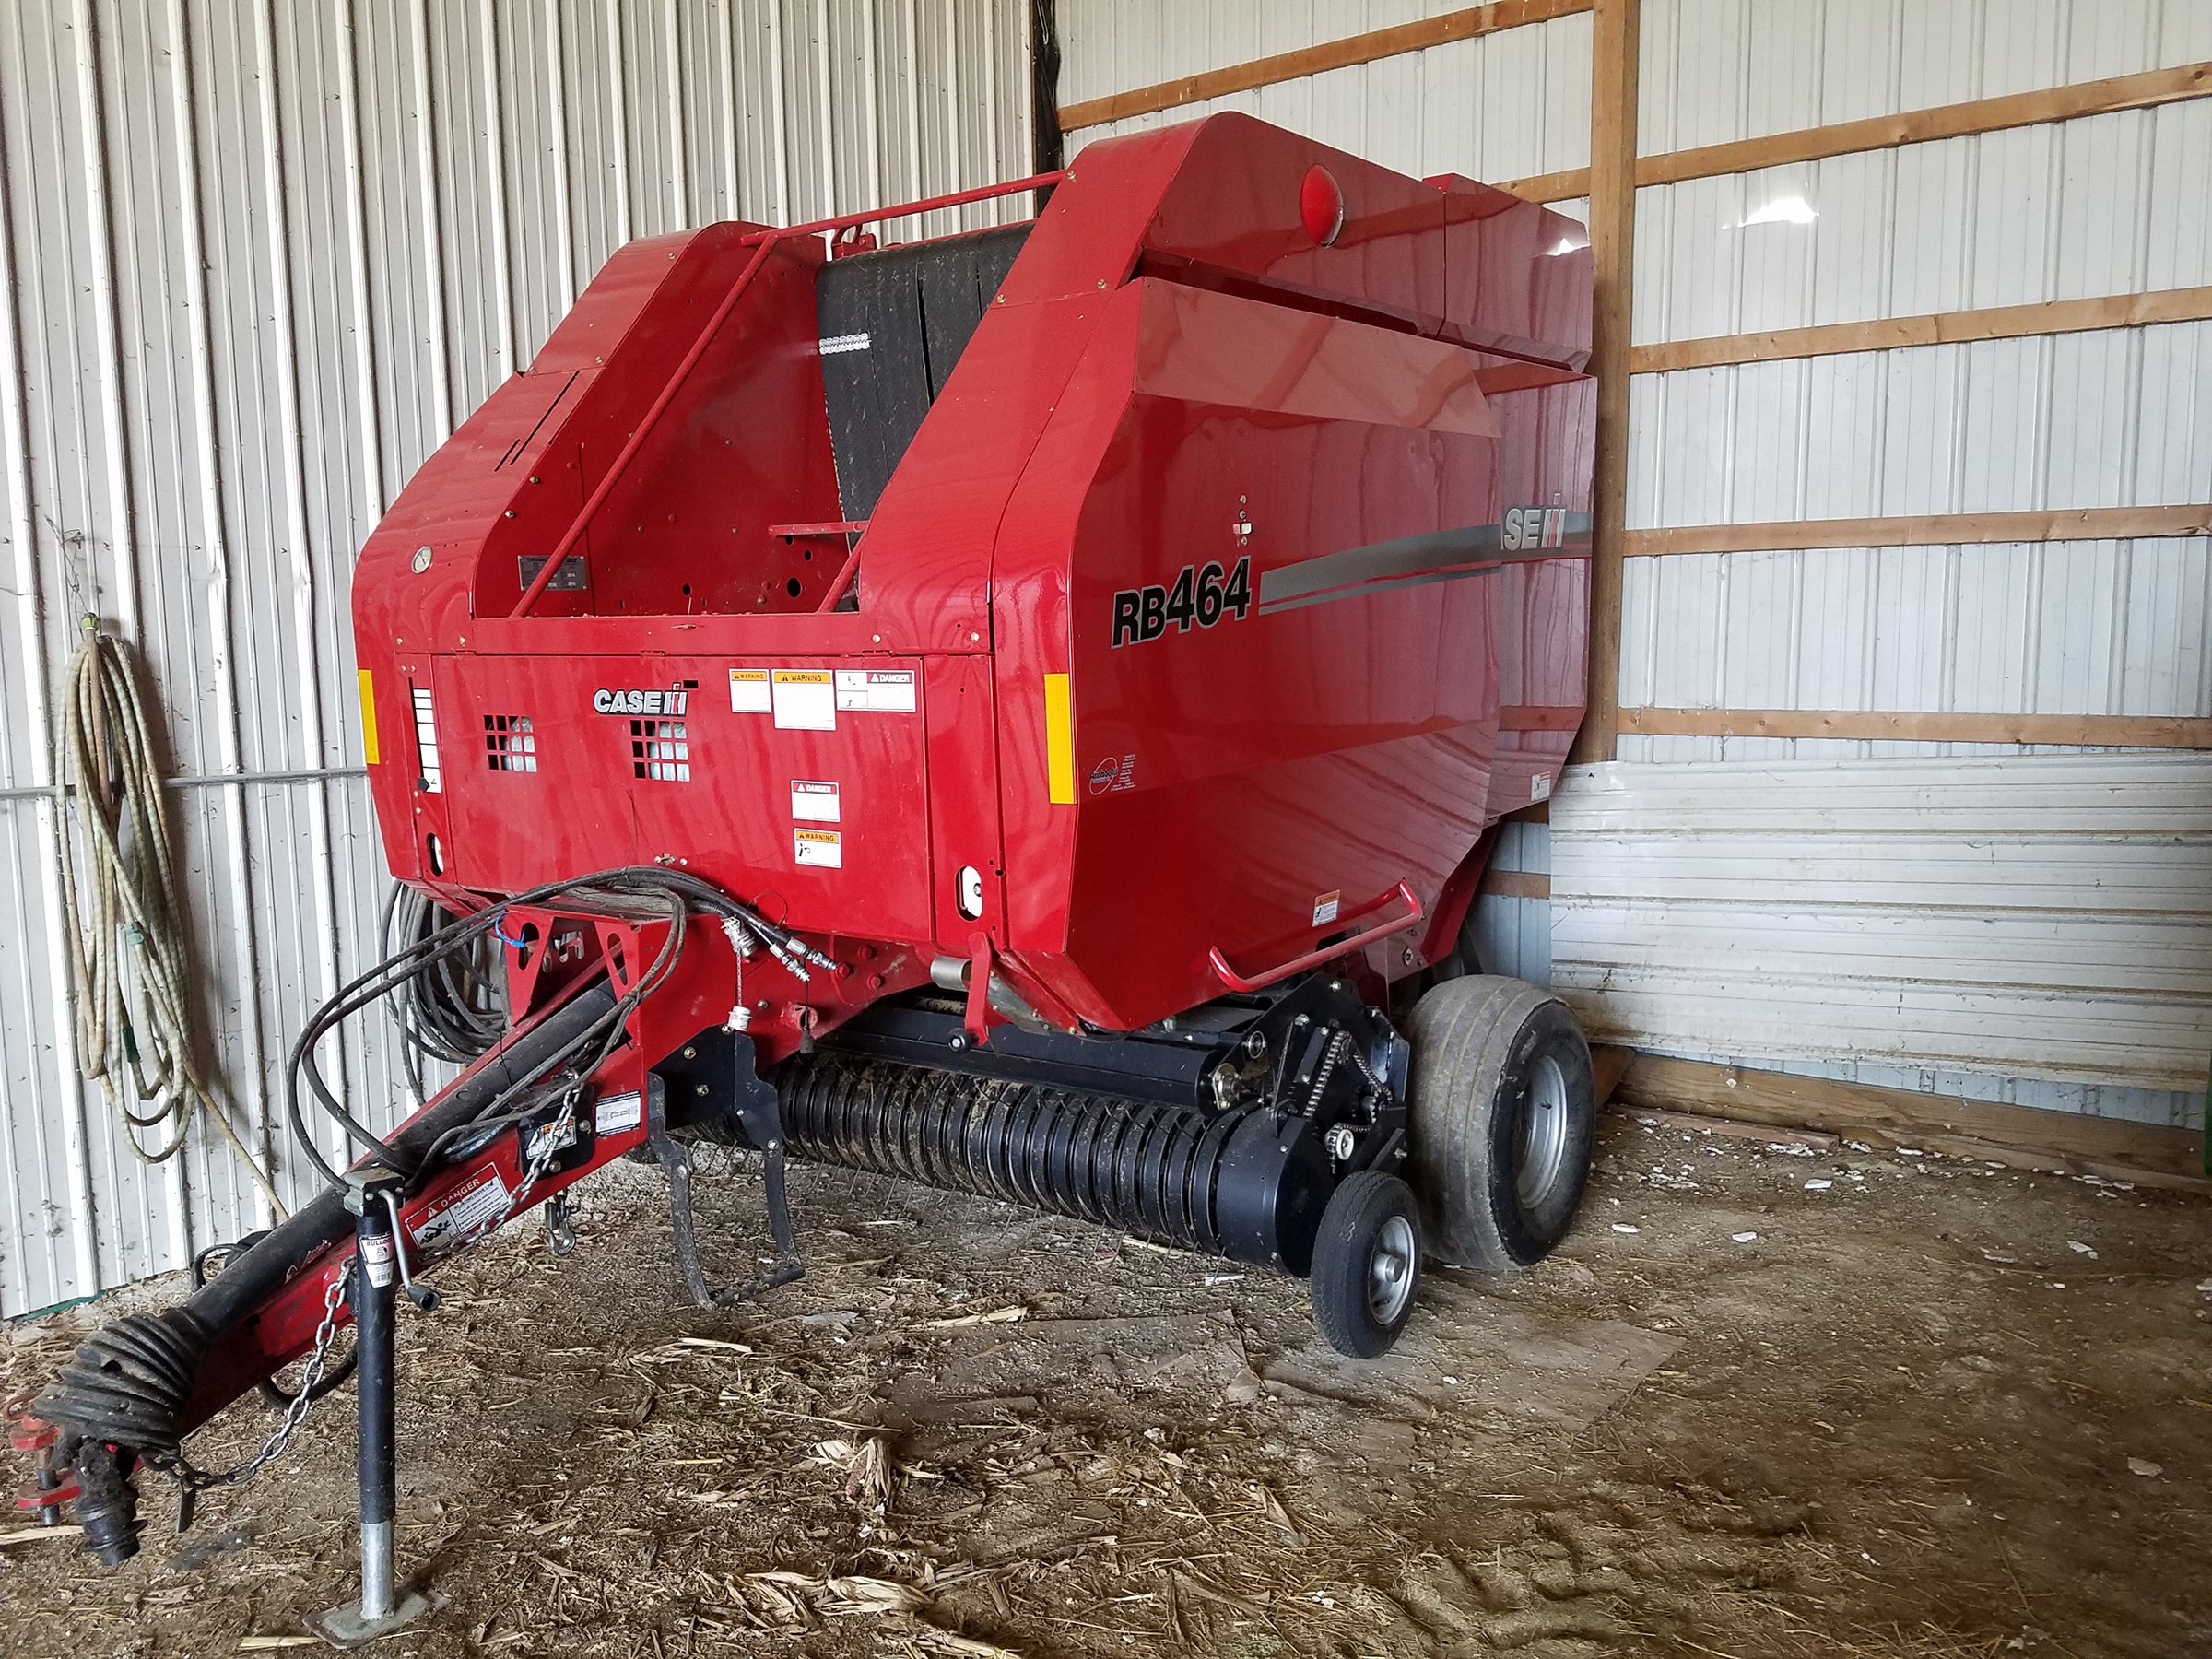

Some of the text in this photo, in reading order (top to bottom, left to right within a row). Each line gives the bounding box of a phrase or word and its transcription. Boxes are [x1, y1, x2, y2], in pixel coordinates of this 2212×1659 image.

[1111, 555, 1252, 649] RB464
[791, 674, 822, 683] WARNING
[879, 673, 910, 683] DANGER
[806, 783, 831, 793] DANGER
[805, 832, 835, 842] WARNING
[441, 1178, 480, 1208] DANGER
[366, 1238, 393, 1247] BULLDO
